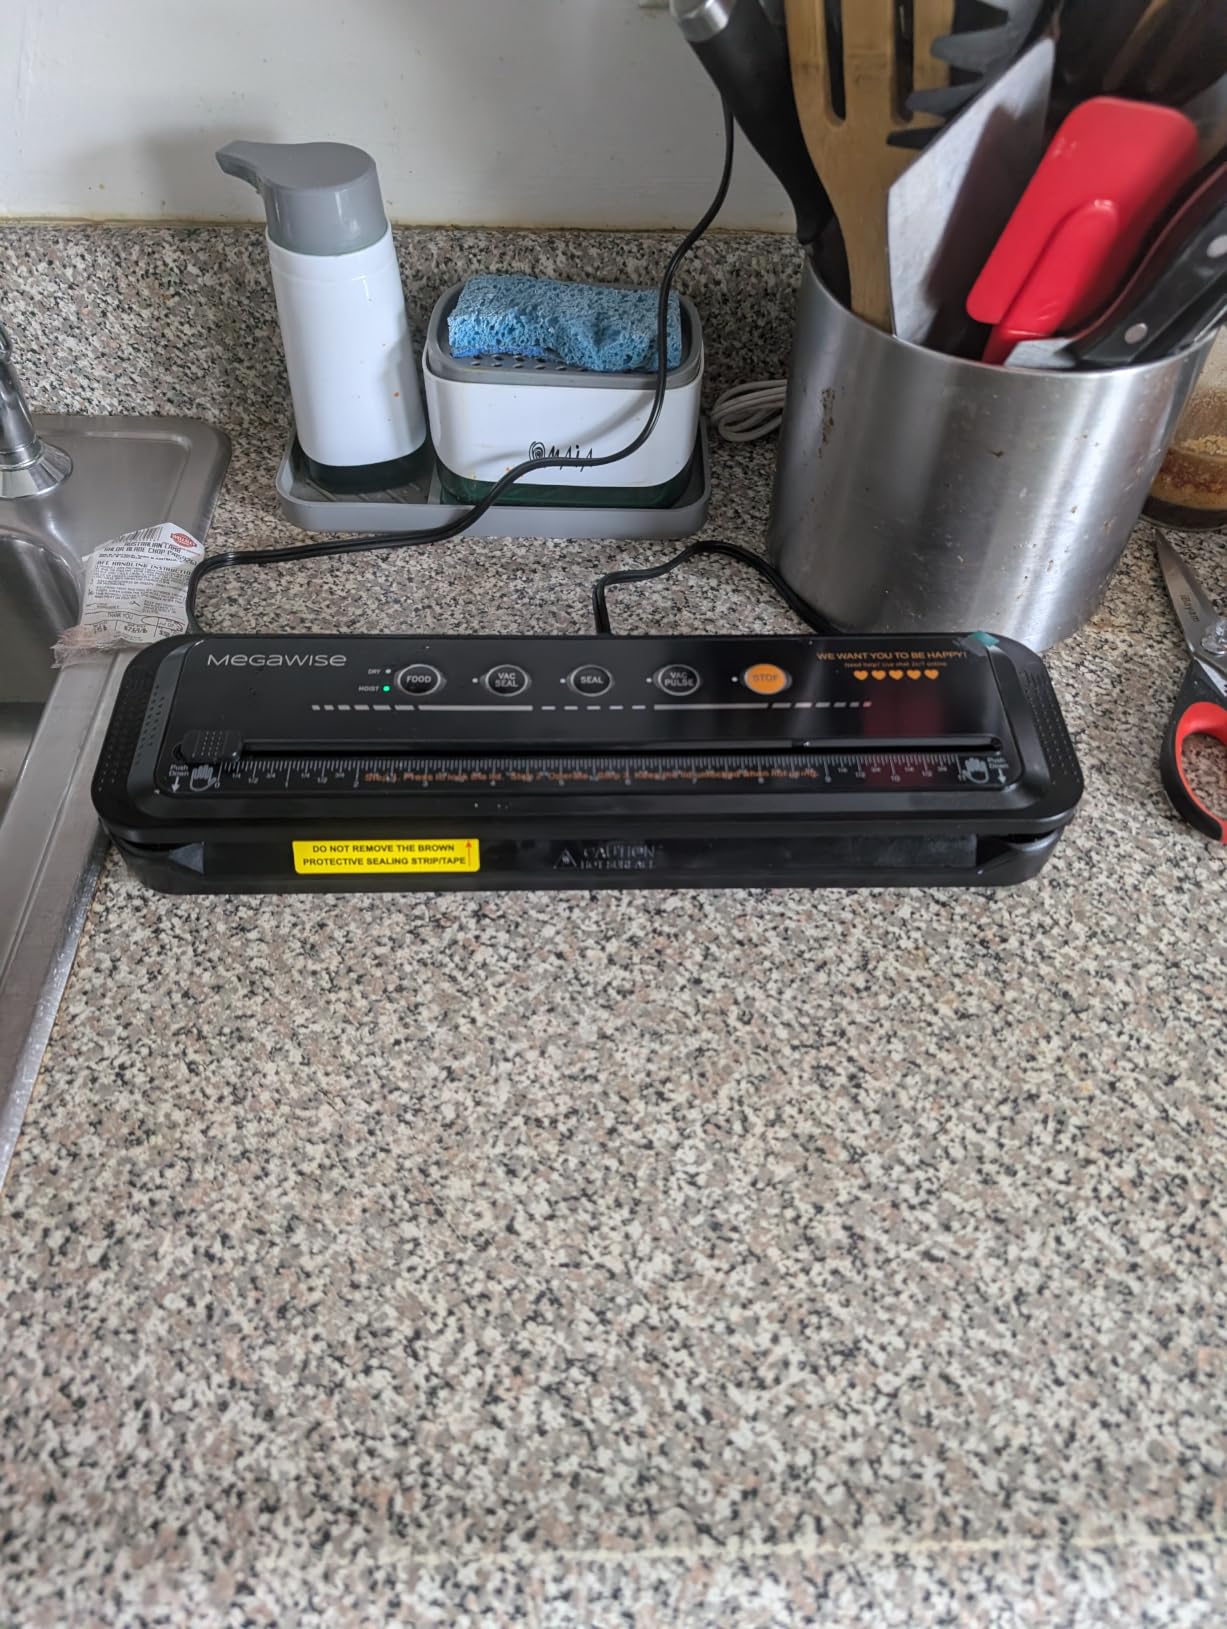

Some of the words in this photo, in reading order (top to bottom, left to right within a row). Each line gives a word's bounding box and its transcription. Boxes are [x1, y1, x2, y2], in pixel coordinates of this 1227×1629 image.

[816, 652, 835, 660] WE
[836, 652, 868, 660] WANT
[869, 651, 894, 660] YOU
[894, 651, 910, 659] TO
[910, 651, 926, 659] BE
[927, 650, 967, 659] HAPPY!
[367, 667, 381, 676] DRY
[498, 672, 516, 680] VAC
[670, 671, 688, 679] VAC
[406, 674, 432, 684] FOOD
[580, 675, 604, 685] SEAL
[751, 673, 778, 682] STOP
[495, 680, 519, 688] SEAL
[664, 678, 694, 687] PULSE
[358, 685, 380, 693] MOIST
[313, 845, 323, 853] DO
[329, 845, 349, 853] NOT
[352, 845, 394, 853] REMOVE
[396, 844, 415, 853] THE
[418, 844, 454, 852] BROWN
[584, 845, 655, 858] CAUTION
[303, 858, 364, 866] PROTECTIVE
[366, 857, 408, 865] SEALING
[411, 857, 466, 865] STRIP/TAPE
